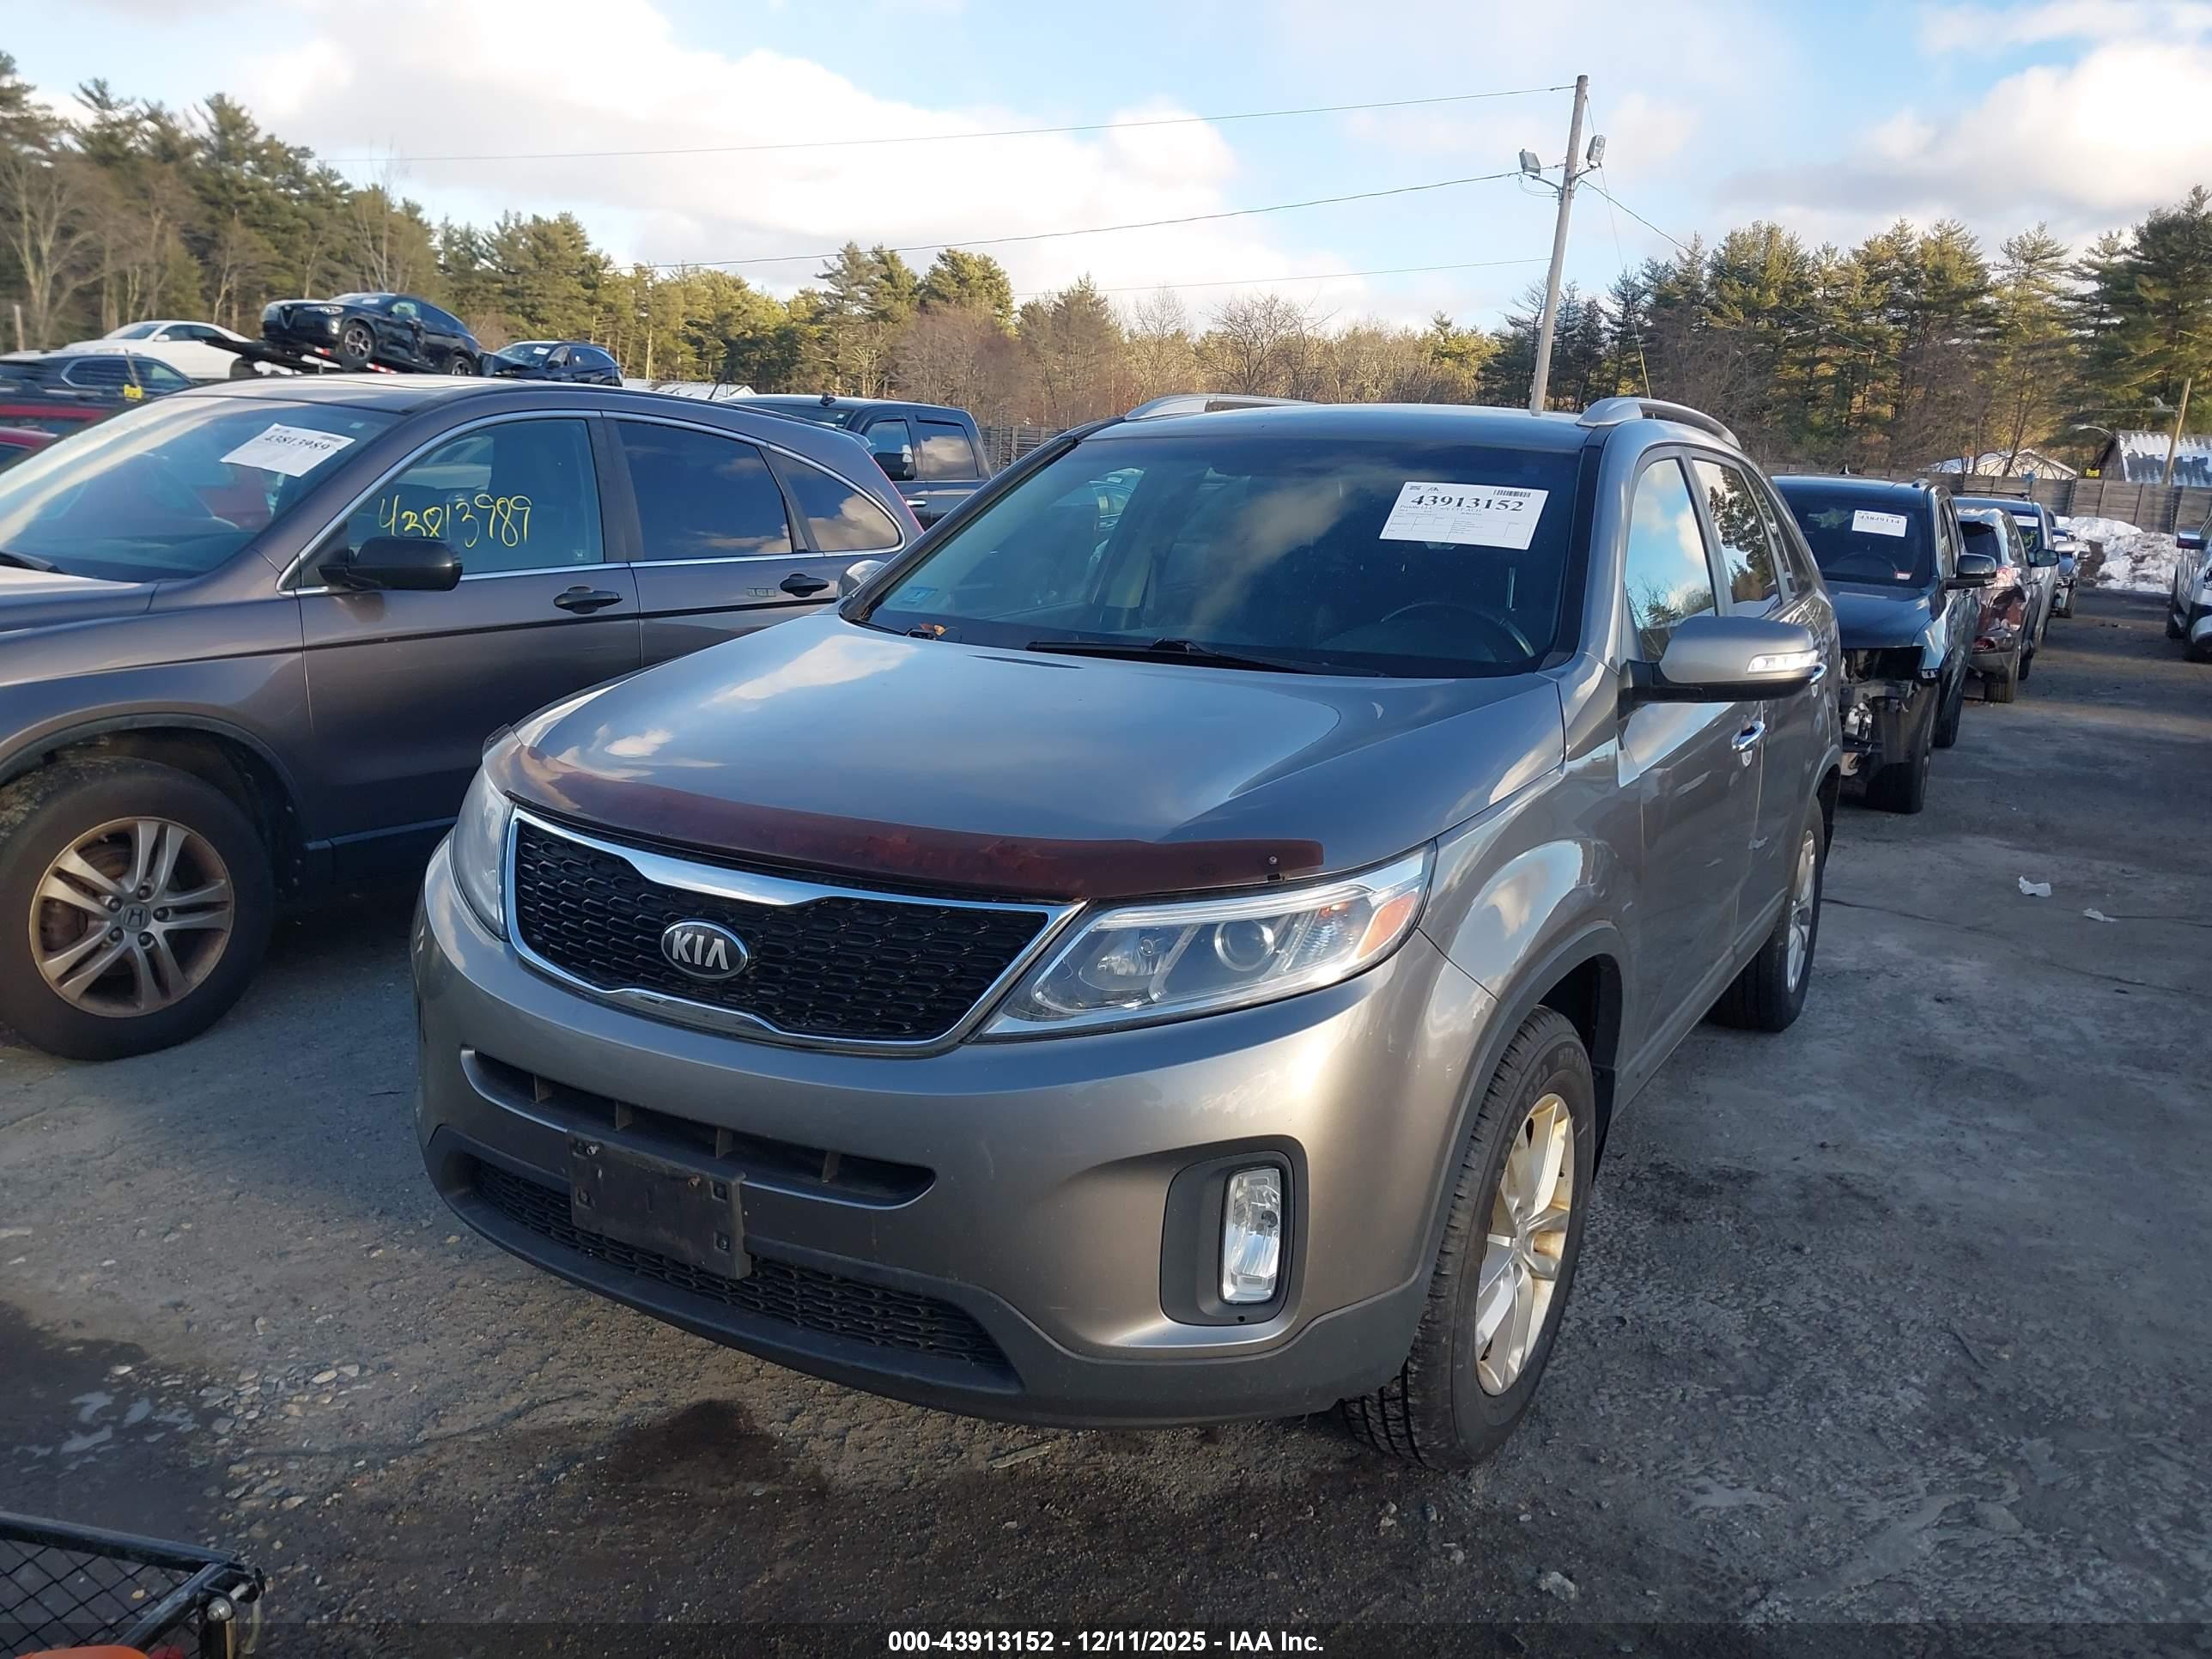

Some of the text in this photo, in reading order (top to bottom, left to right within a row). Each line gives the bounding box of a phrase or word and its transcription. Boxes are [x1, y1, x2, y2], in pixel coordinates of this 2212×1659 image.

[378, 493, 532, 548] 43813989
[1410, 495, 1525, 512] 43913152
[672, 930, 729, 970] KIA
